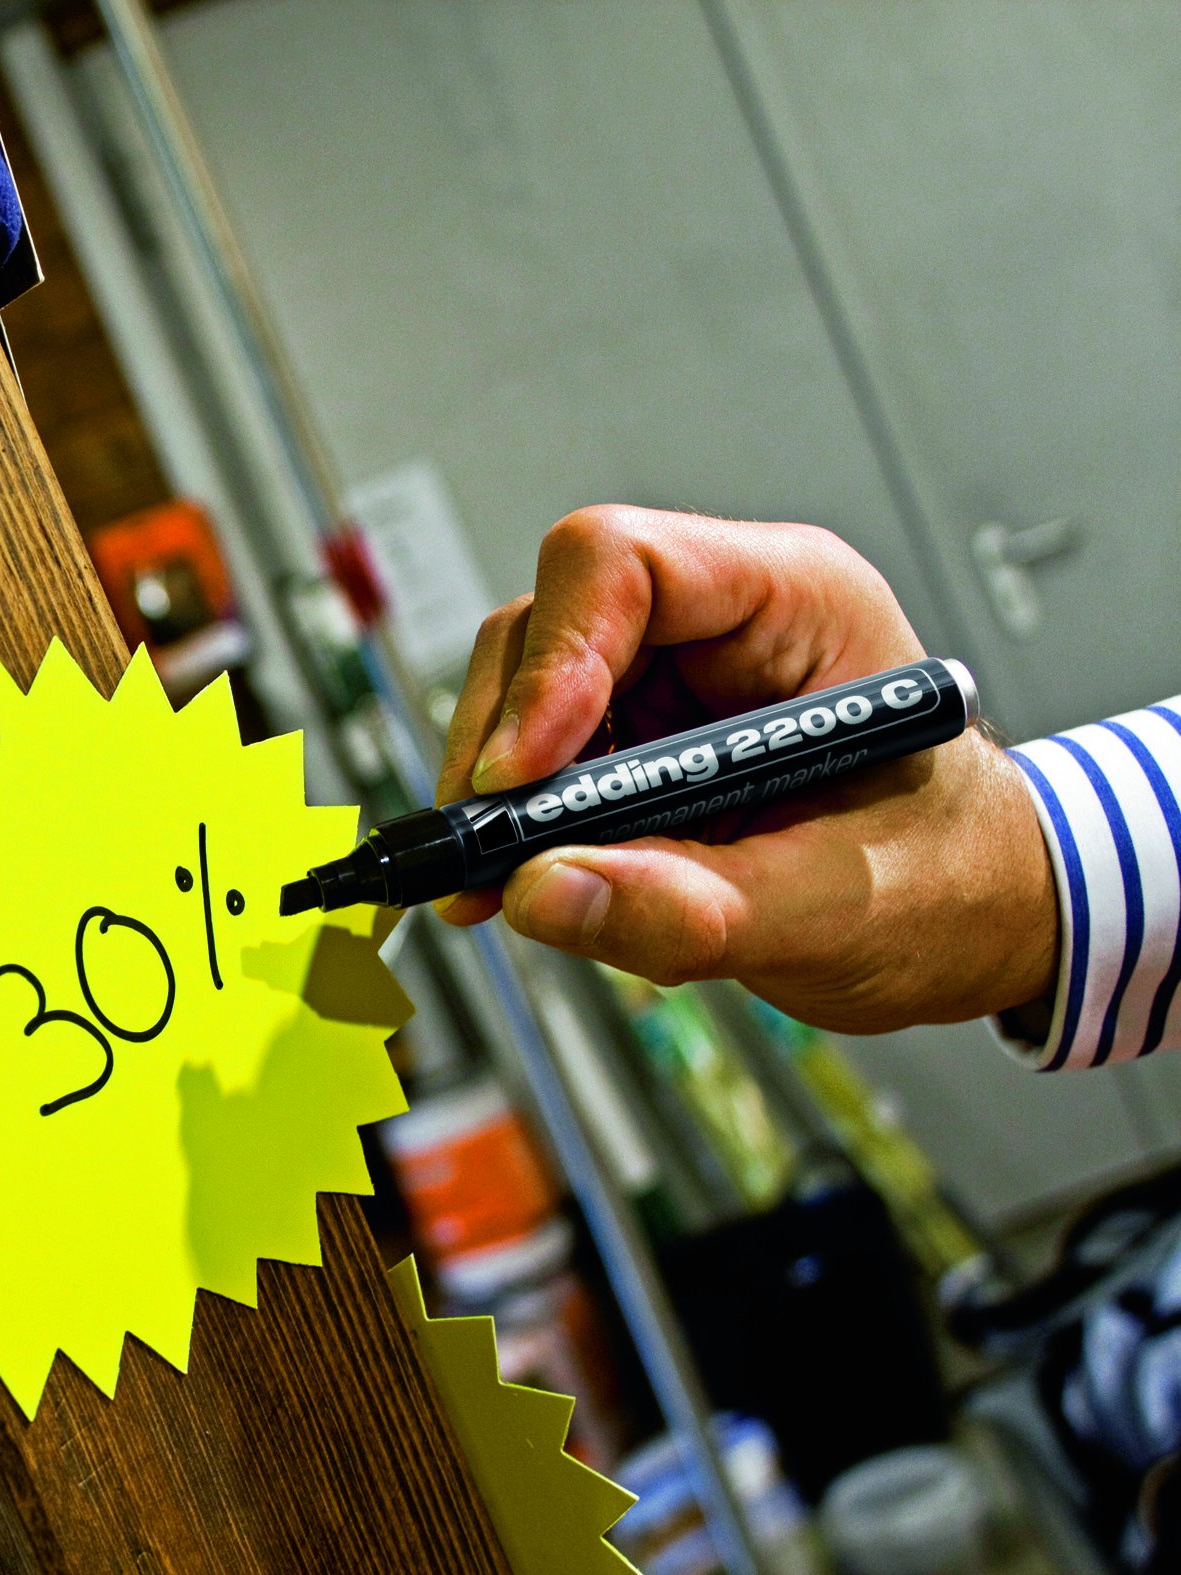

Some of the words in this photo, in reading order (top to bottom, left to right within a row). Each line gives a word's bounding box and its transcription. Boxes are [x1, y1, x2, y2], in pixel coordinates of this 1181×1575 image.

[525, 741, 719, 823] edding
[726, 695, 874, 765] 2200
[881, 677, 924, 711] C
[597, 781, 756, 843] permanent
[762, 747, 869, 800] marker
